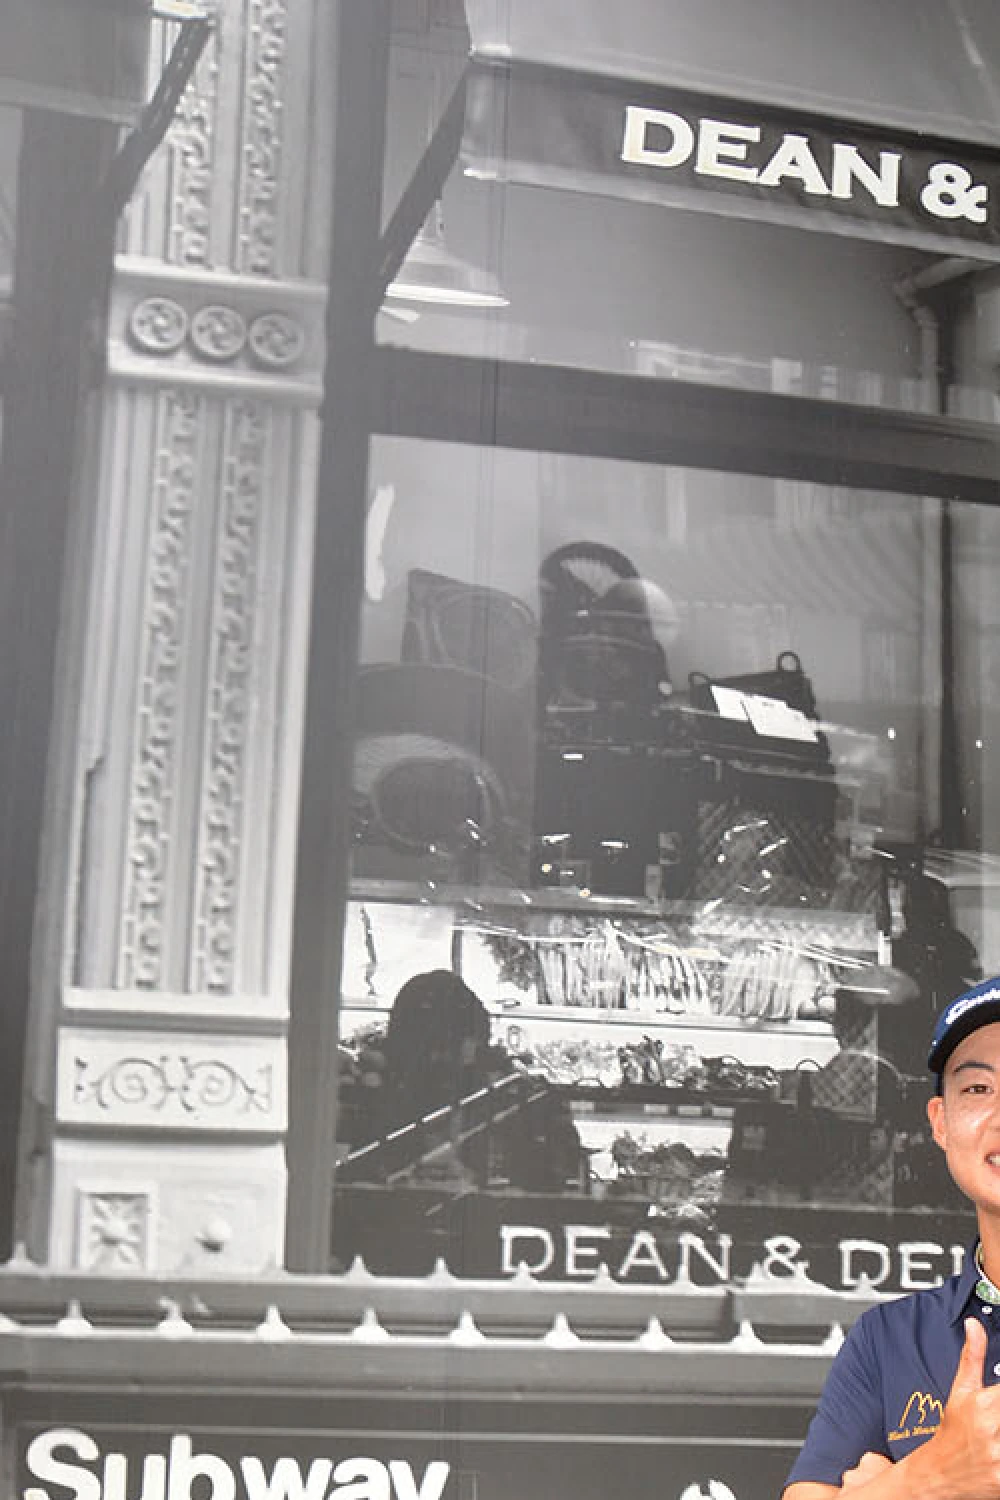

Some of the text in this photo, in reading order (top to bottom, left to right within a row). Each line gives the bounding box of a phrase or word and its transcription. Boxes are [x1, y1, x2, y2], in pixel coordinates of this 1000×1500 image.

[620, 105, 902, 207] DEAN
[920, 162, 989, 223] &
[500, 1225, 733, 1282] DEAN
[763, 1236, 810, 1279] &
